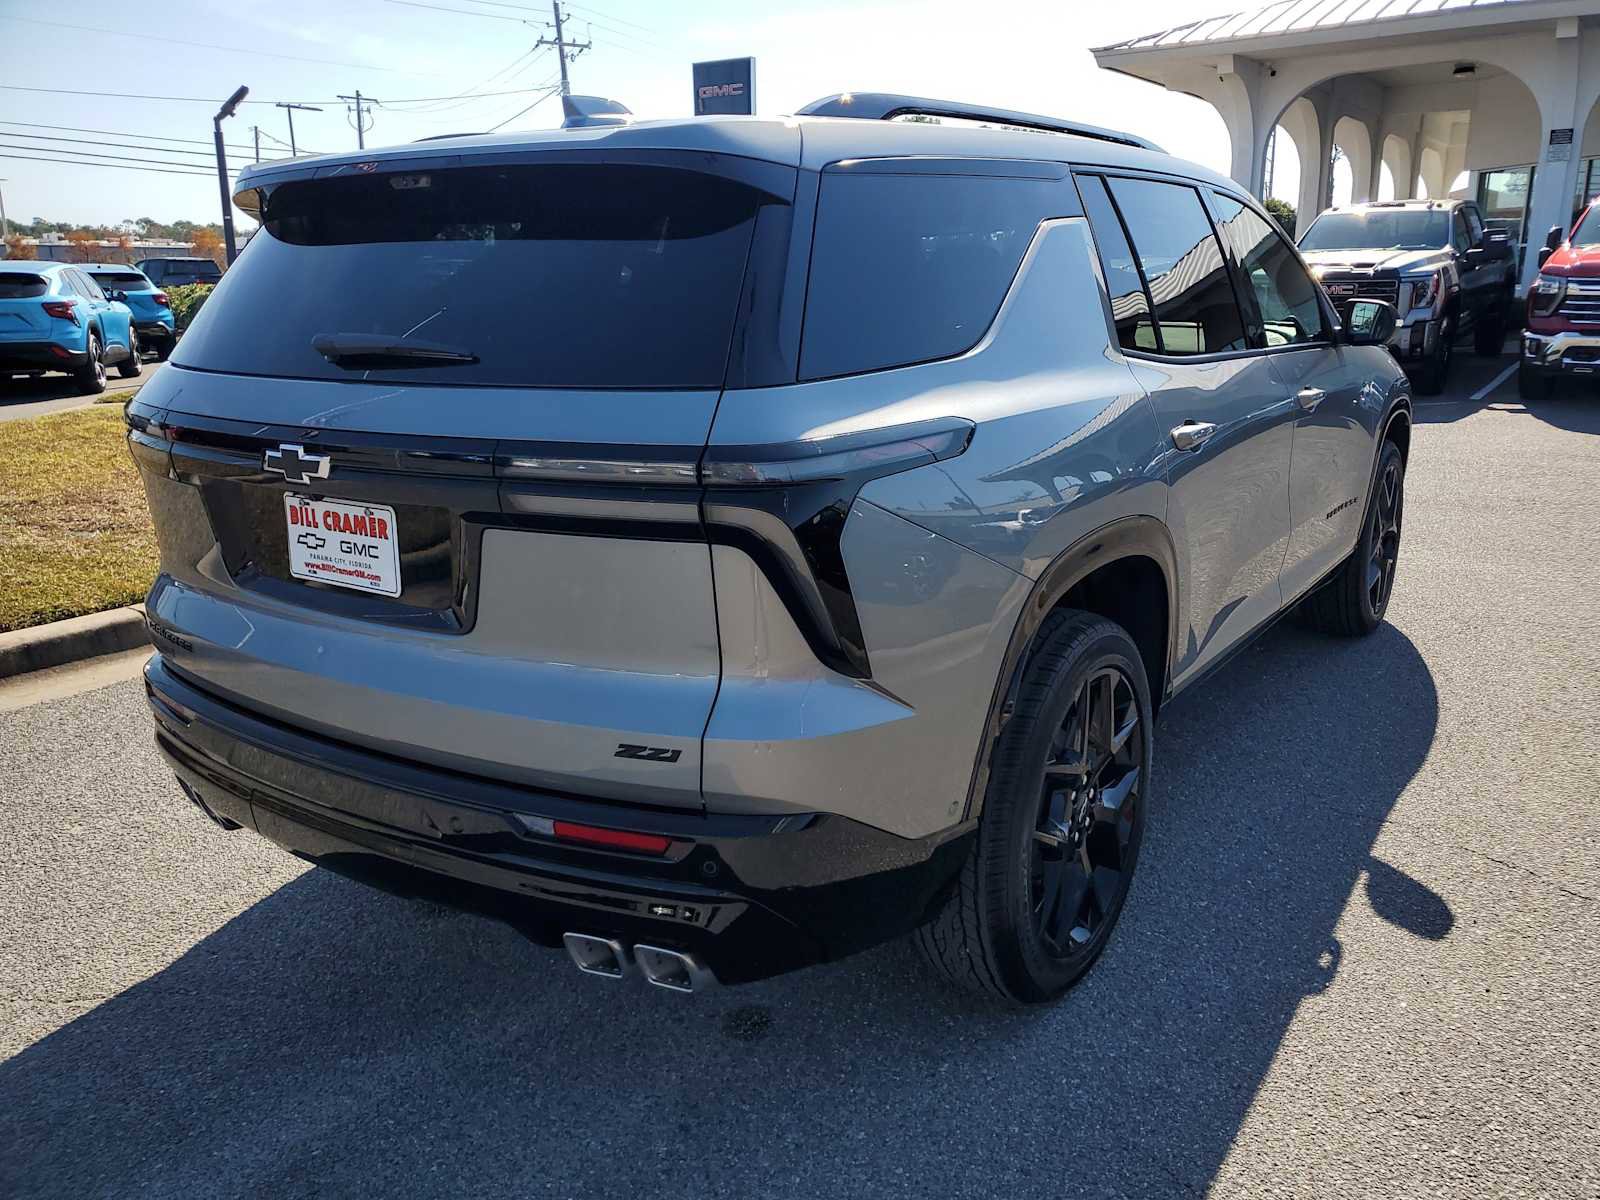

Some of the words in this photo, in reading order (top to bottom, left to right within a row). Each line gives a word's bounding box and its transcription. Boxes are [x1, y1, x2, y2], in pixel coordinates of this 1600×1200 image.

[699, 83, 744, 98] GMC
[1321, 285, 1354, 295] MC
[289, 504, 319, 529] BILL
[322, 510, 389, 540] CRAMER
[340, 540, 380, 559] GMC
[614, 743, 683, 763] Z71
